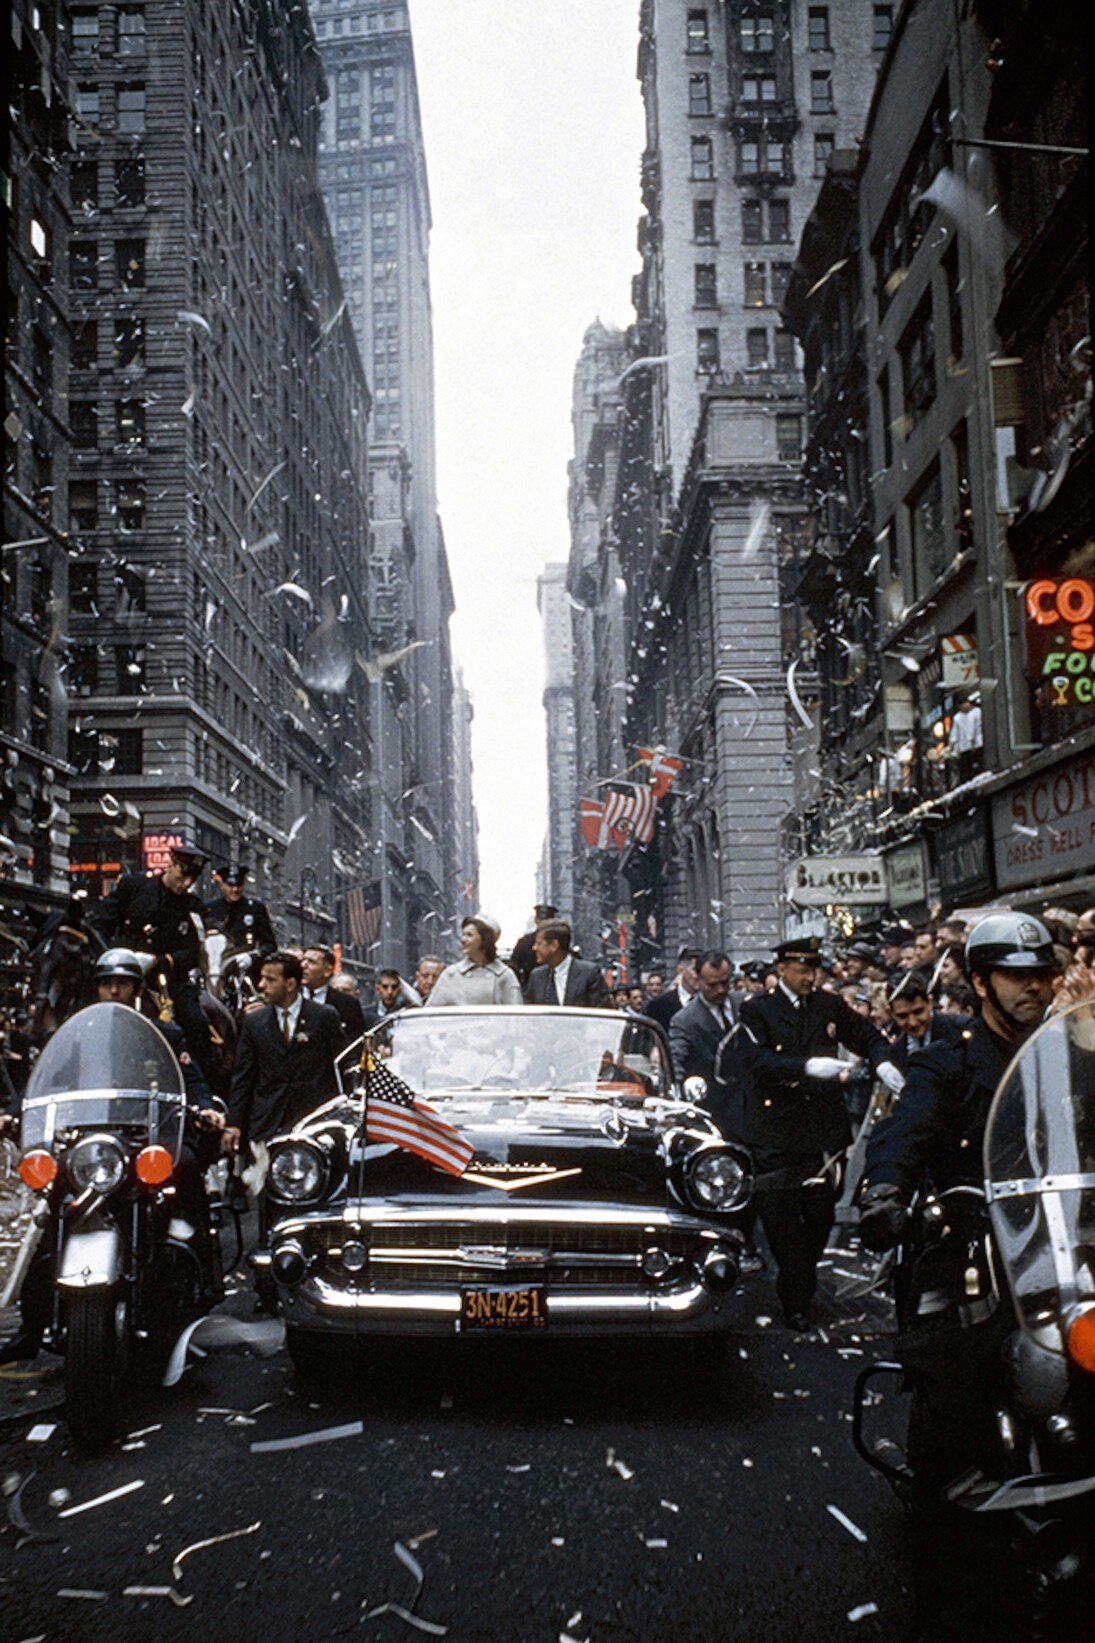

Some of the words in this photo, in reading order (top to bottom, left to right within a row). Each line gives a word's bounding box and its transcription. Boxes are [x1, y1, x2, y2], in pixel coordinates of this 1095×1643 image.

[1027, 578, 1095, 625] CO
[1042, 651, 1095, 675] FO
[1074, 676, 1095, 703] C
[1011, 763, 1095, 828] SCOT
[147, 853, 172, 868] LOA
